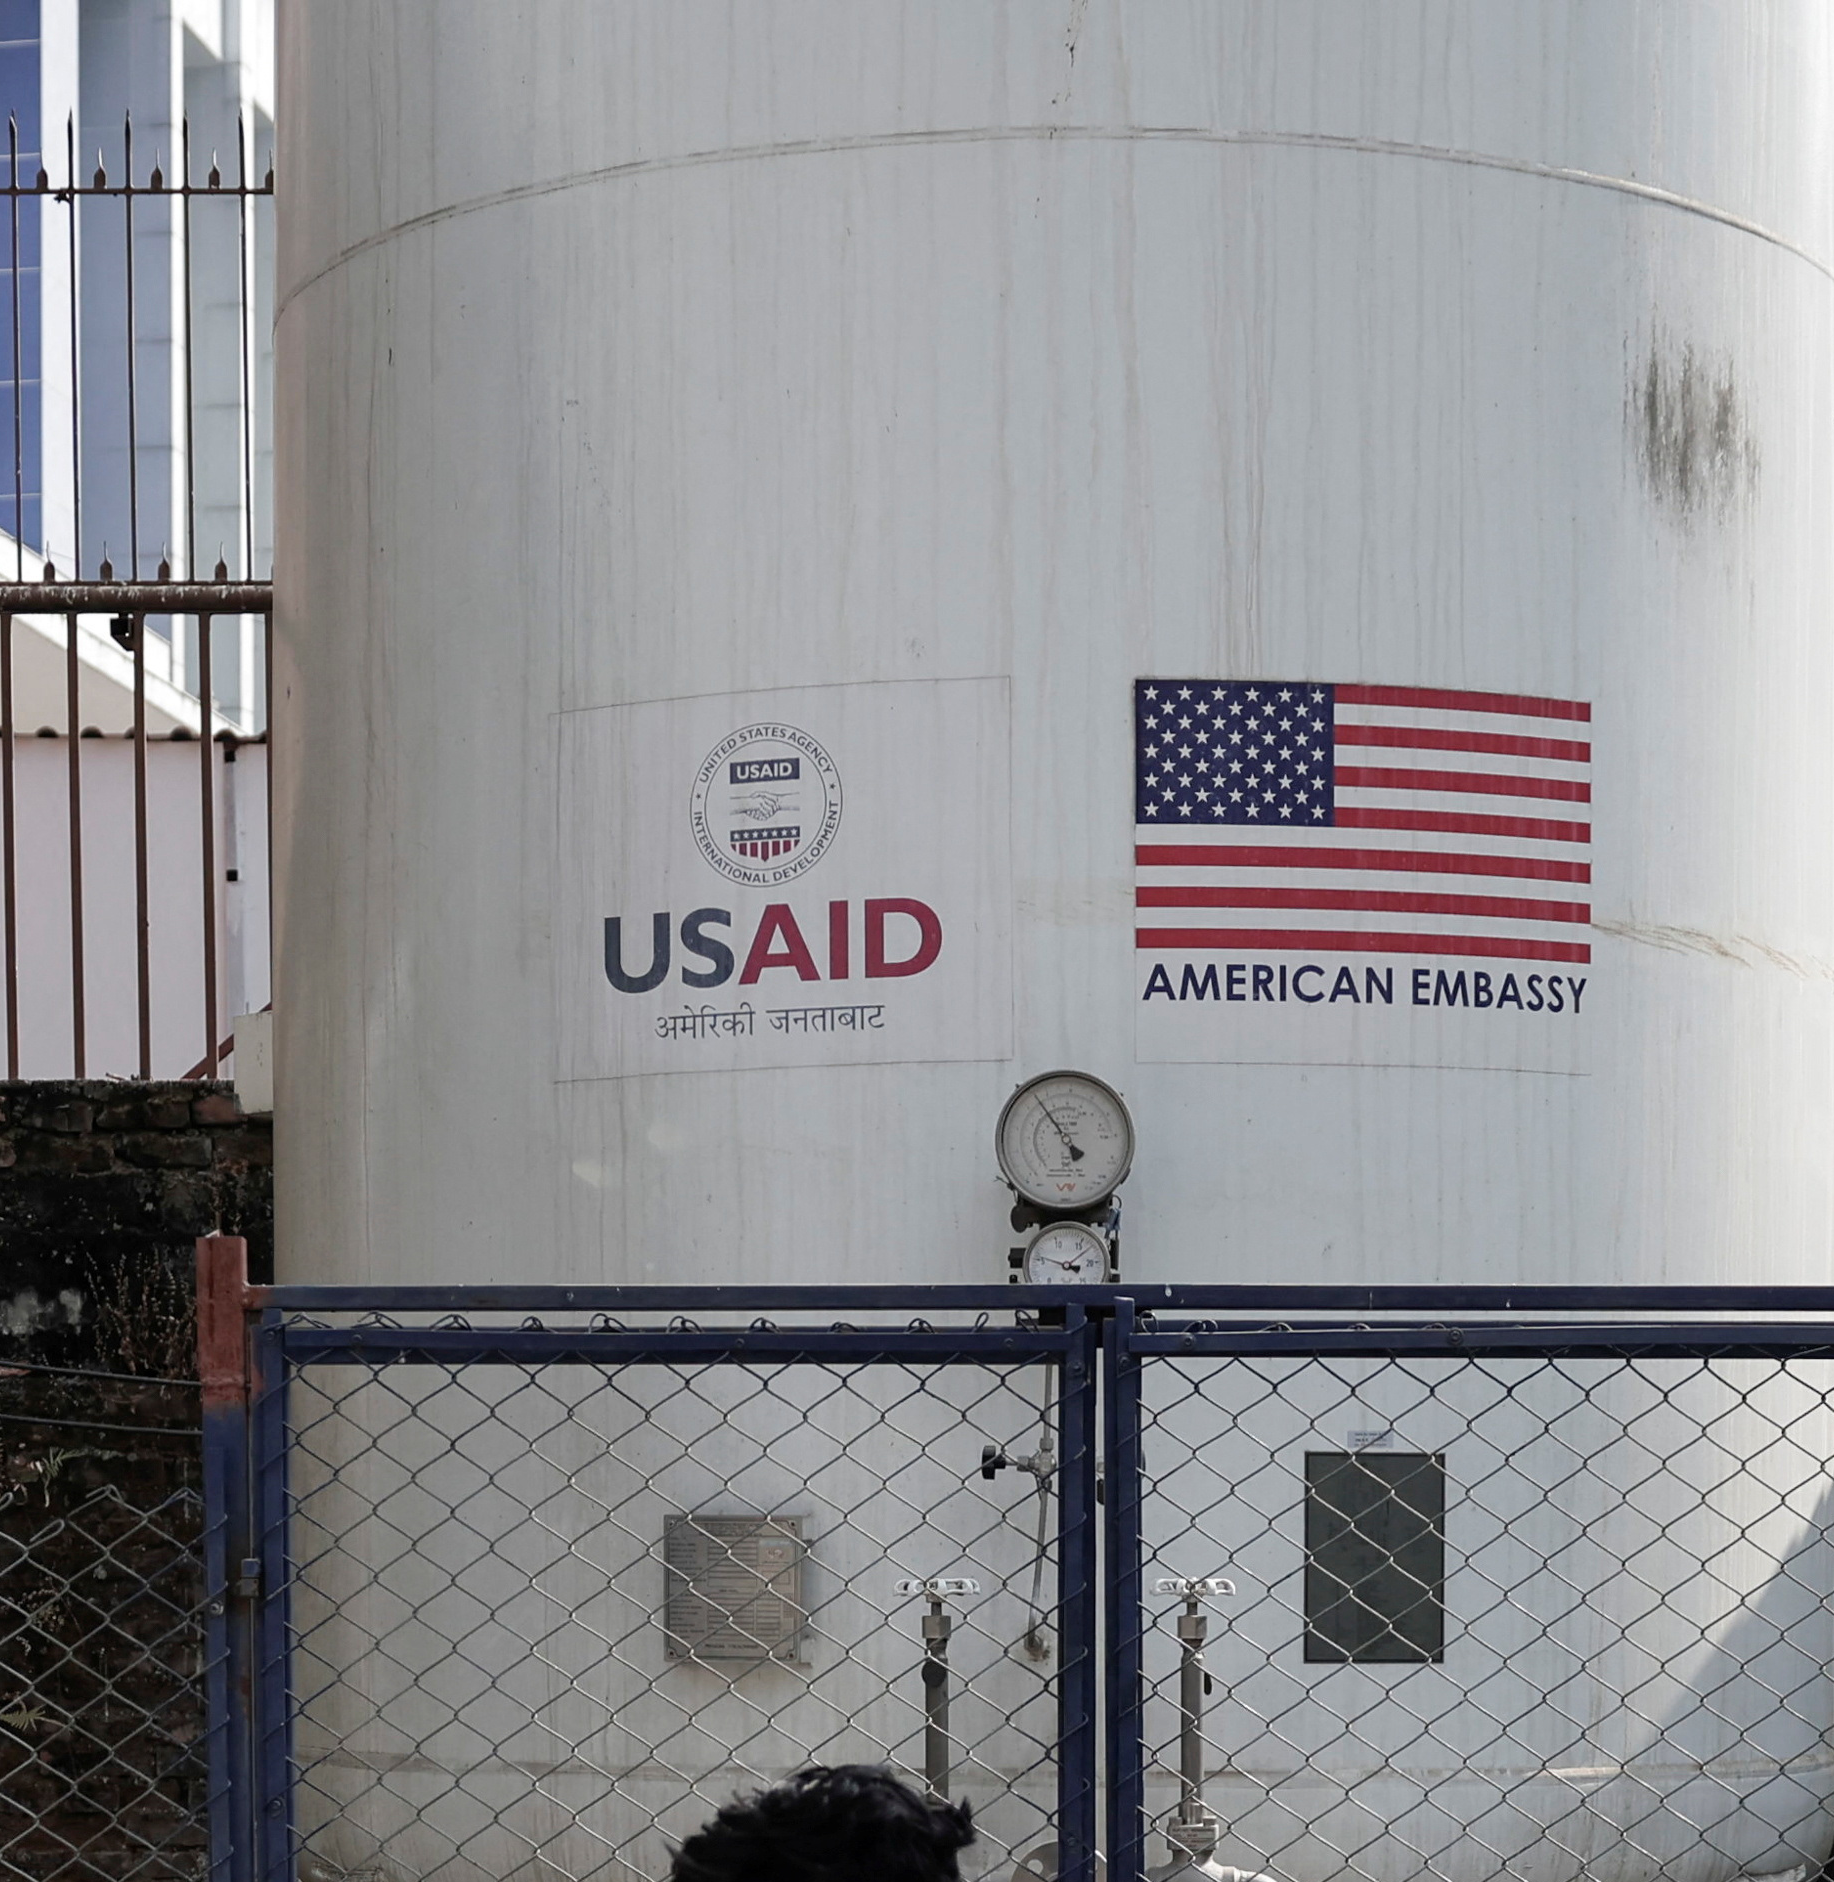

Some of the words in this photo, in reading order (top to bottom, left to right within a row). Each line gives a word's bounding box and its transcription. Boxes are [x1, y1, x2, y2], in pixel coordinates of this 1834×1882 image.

[699, 738, 737, 784] UNITED
[739, 726, 786, 743] STATES
[787, 732, 834, 774] AGENCY
[736, 762, 793, 780] USAID
[693, 811, 770, 884] INTERNATIONAL
[773, 799, 839, 883] DEVELOPMENT
[603, 897, 943, 995] USAID
[1142, 963, 1394, 1005] AMERICAN
[1411, 967, 1588, 1015] EMBASSY
[654, 1001, 756, 1041] अमेरिकी
[765, 1003, 886, 1035] जनताबाट
